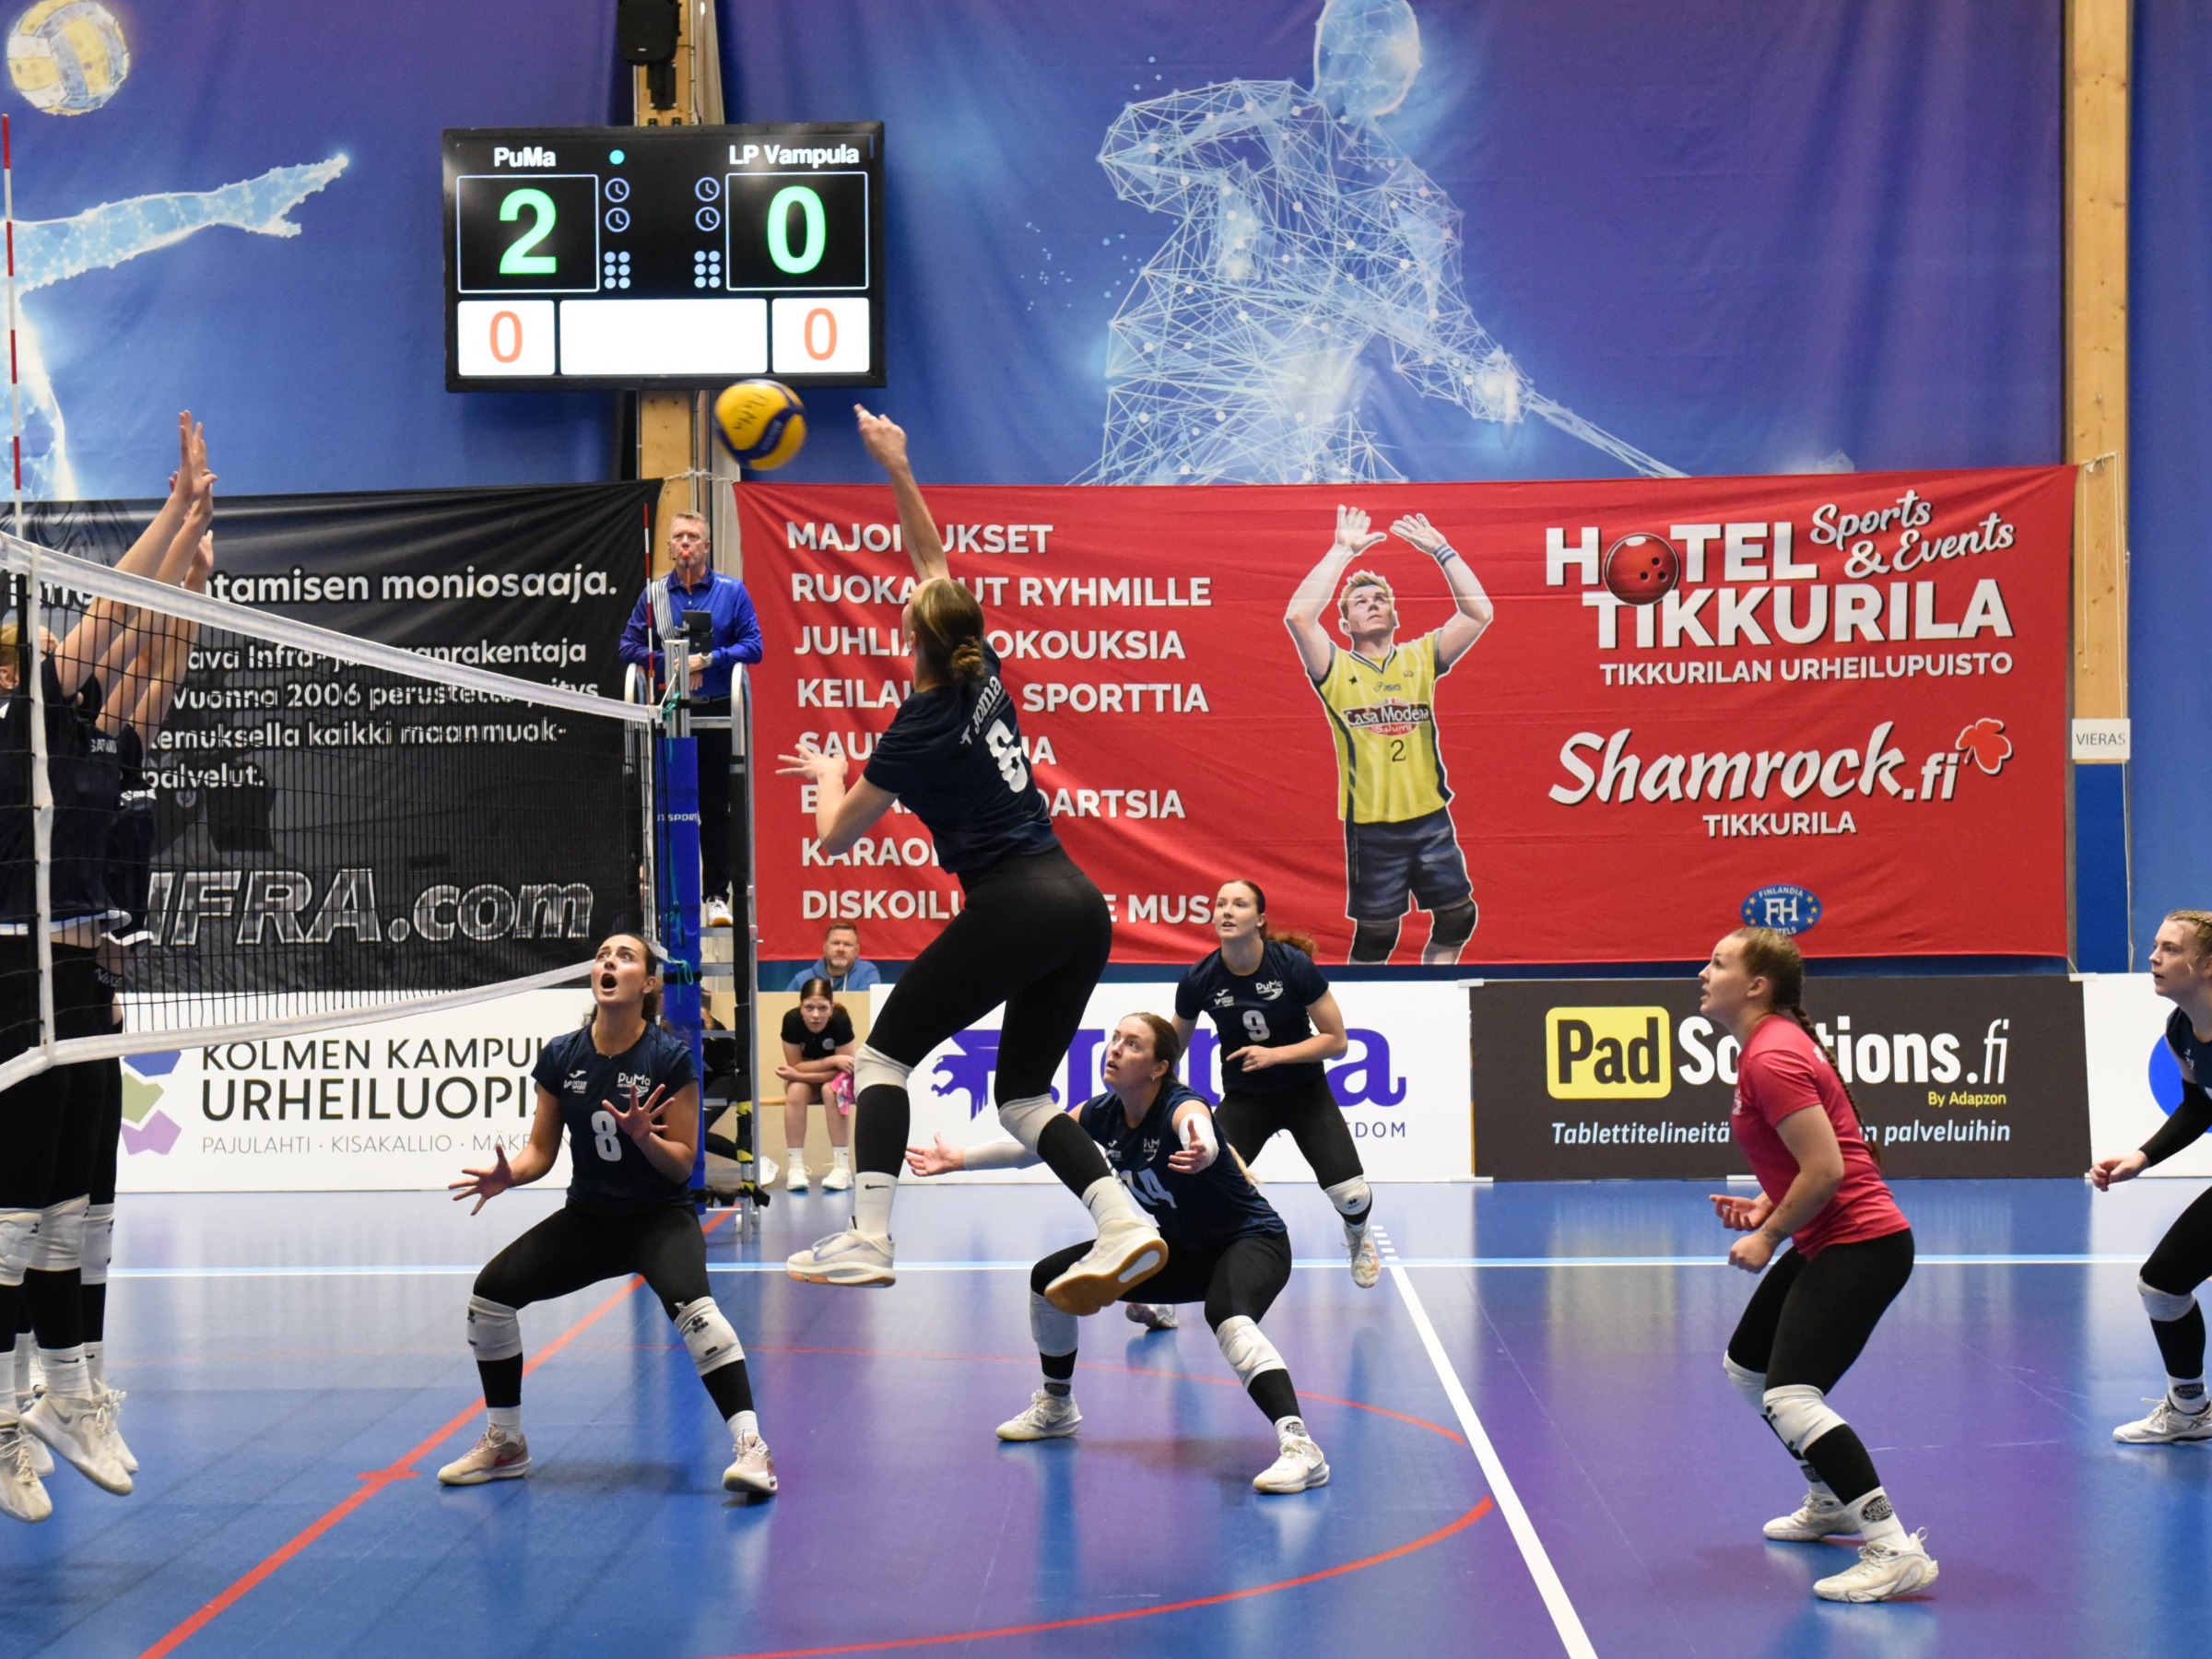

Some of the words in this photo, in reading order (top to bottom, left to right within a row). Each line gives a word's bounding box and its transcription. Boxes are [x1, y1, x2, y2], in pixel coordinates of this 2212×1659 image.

[494, 147, 557, 168] PuMa
[729, 145, 759, 165] LP
[763, 145, 860, 169] Vampula
[499, 188, 557, 275] 2
[767, 185, 827, 274] 0
[489, 311, 523, 363] 0
[804, 308, 838, 361] 0
[1810, 489, 1932, 550] Sports
[1546, 522, 1818, 601] HOTEL
[1844, 540, 1890, 579] &
[1893, 512, 2015, 571] Events
[382, 563, 618, 603] moniosaaja.
[1019, 577, 1213, 606] RYHMILLE
[1582, 579, 2015, 649] TIKKURILA
[794, 626, 912, 656] JUHLI
[985, 629, 1186, 660] OKOUKSIA
[1600, 660, 1772, 686] TIKKURILAN
[1780, 652, 2014, 681] URHEILUPUISTO
[287, 682, 361, 708] 2006
[1022, 682, 1209, 713] SPORTTIA
[308, 720, 392, 747] kaikki
[2076, 733, 2126, 747] VIERAS
[1390, 739, 1406, 762] 2
[1548, 721, 1960, 806] Shamrock.fi
[1703, 811, 1857, 837] TIKKURILA
[1759, 887, 1804, 898] FINLANDIA
[1763, 896, 1799, 926] FH
[1242, 1009, 1270, 1041] 9
[202, 1039, 371, 1071] KOLMEN
[1558, 1017, 1662, 1085] Pad
[202, 1076, 537, 1121] URHEILUOPI
[1928, 1092, 1946, 1108] By
[1949, 1091, 2006, 1108] Adapzon
[202, 1135, 311, 1154] PAJULAHTI
[331, 1134, 453, 1154] KISAKALLIO
[591, 1111, 622, 1162] 8
[1552, 1122, 1730, 1145] Tablettitelineitä
[1884, 1121, 2011, 1146] palveluihin
